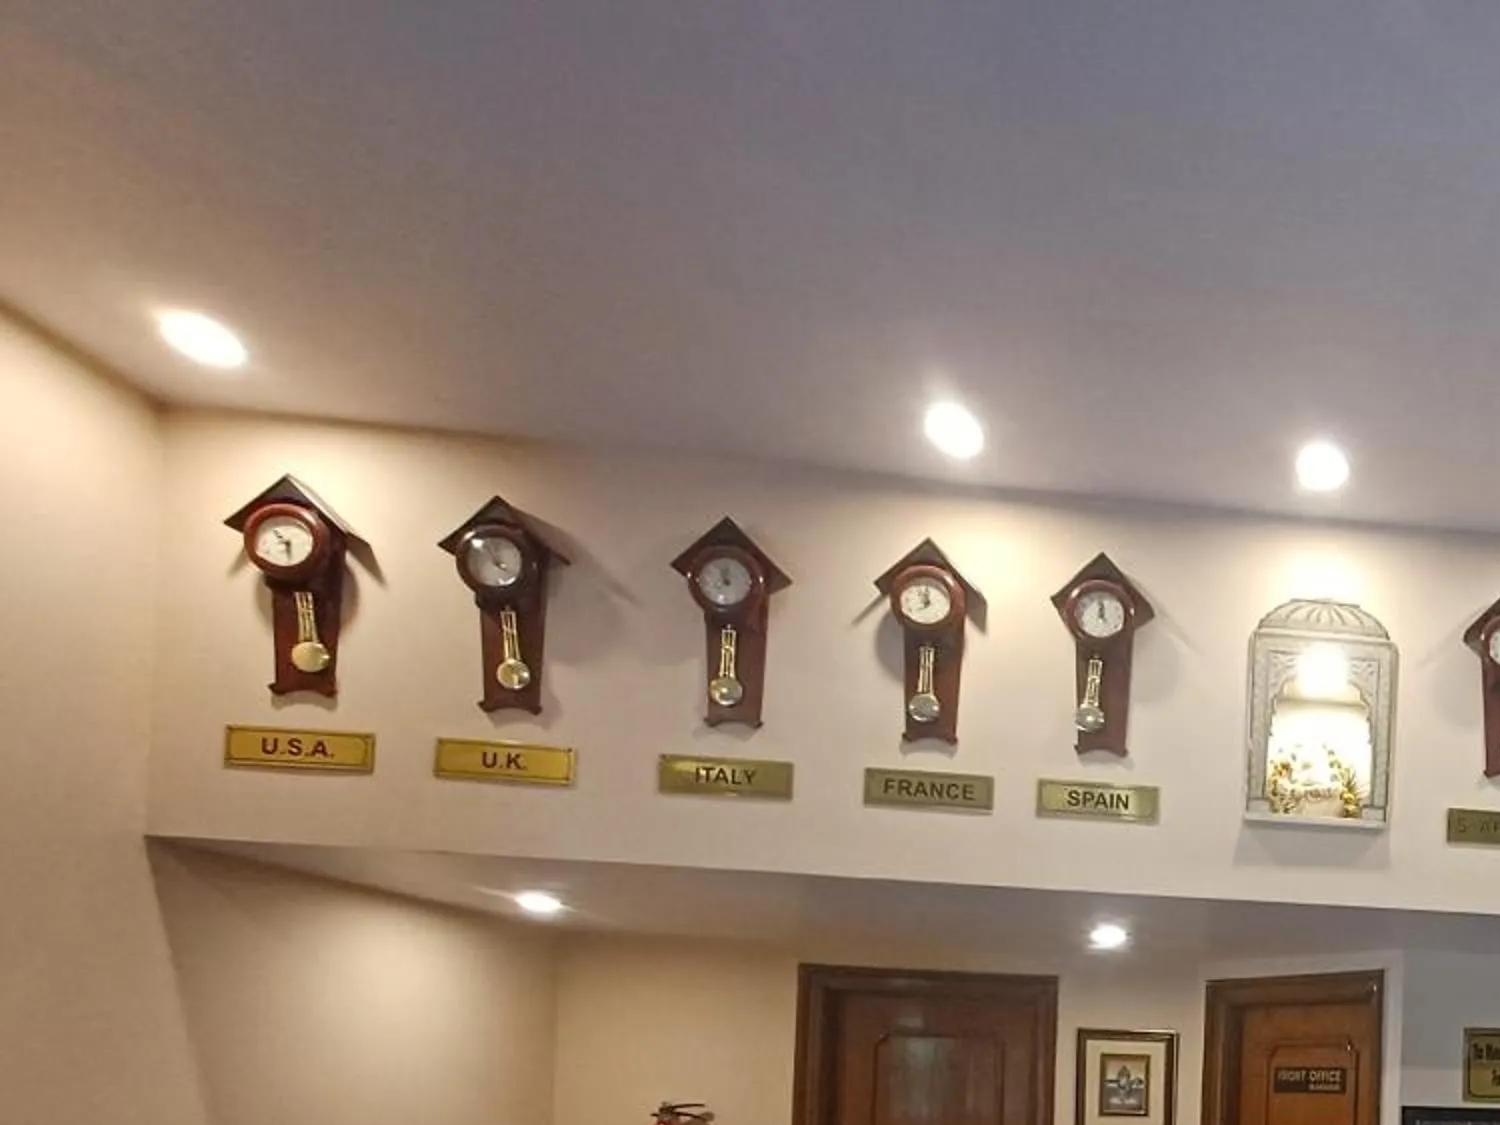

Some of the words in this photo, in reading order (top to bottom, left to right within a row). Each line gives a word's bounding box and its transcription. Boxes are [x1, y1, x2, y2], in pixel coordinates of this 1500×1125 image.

[261, 737, 335, 759] U.S.A.
[481, 751, 526, 771] U.K.
[694, 766, 757, 785] ITALY
[882, 778, 976, 801] FRANCE
[1067, 790, 1130, 810] SPAIN
